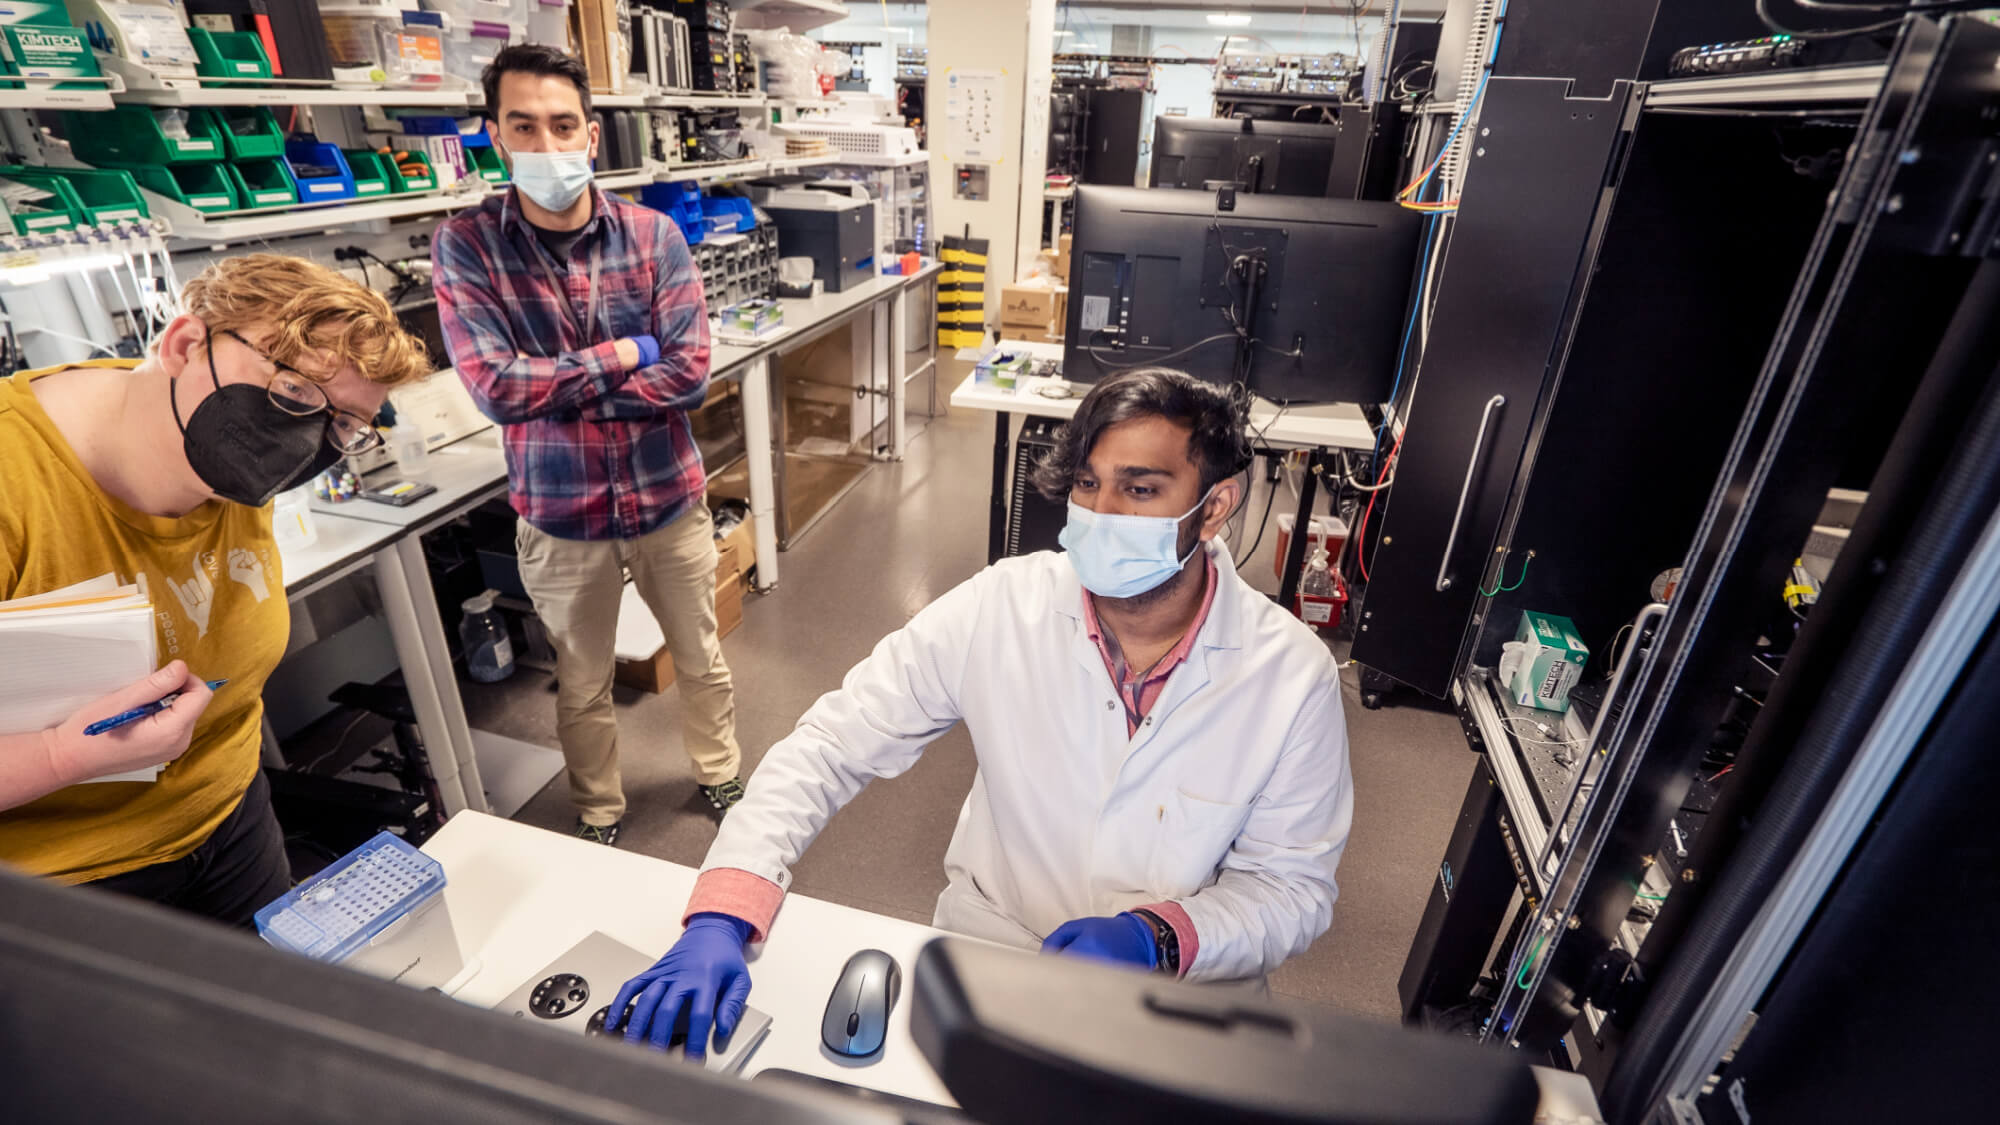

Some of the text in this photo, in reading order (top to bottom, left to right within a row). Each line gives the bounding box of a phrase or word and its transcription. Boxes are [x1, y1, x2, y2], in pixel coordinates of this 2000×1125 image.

[17, 32, 81, 47] KIMTECH
[156, 611, 179, 655] peace
[1541, 660, 1564, 698] KIMTECH
